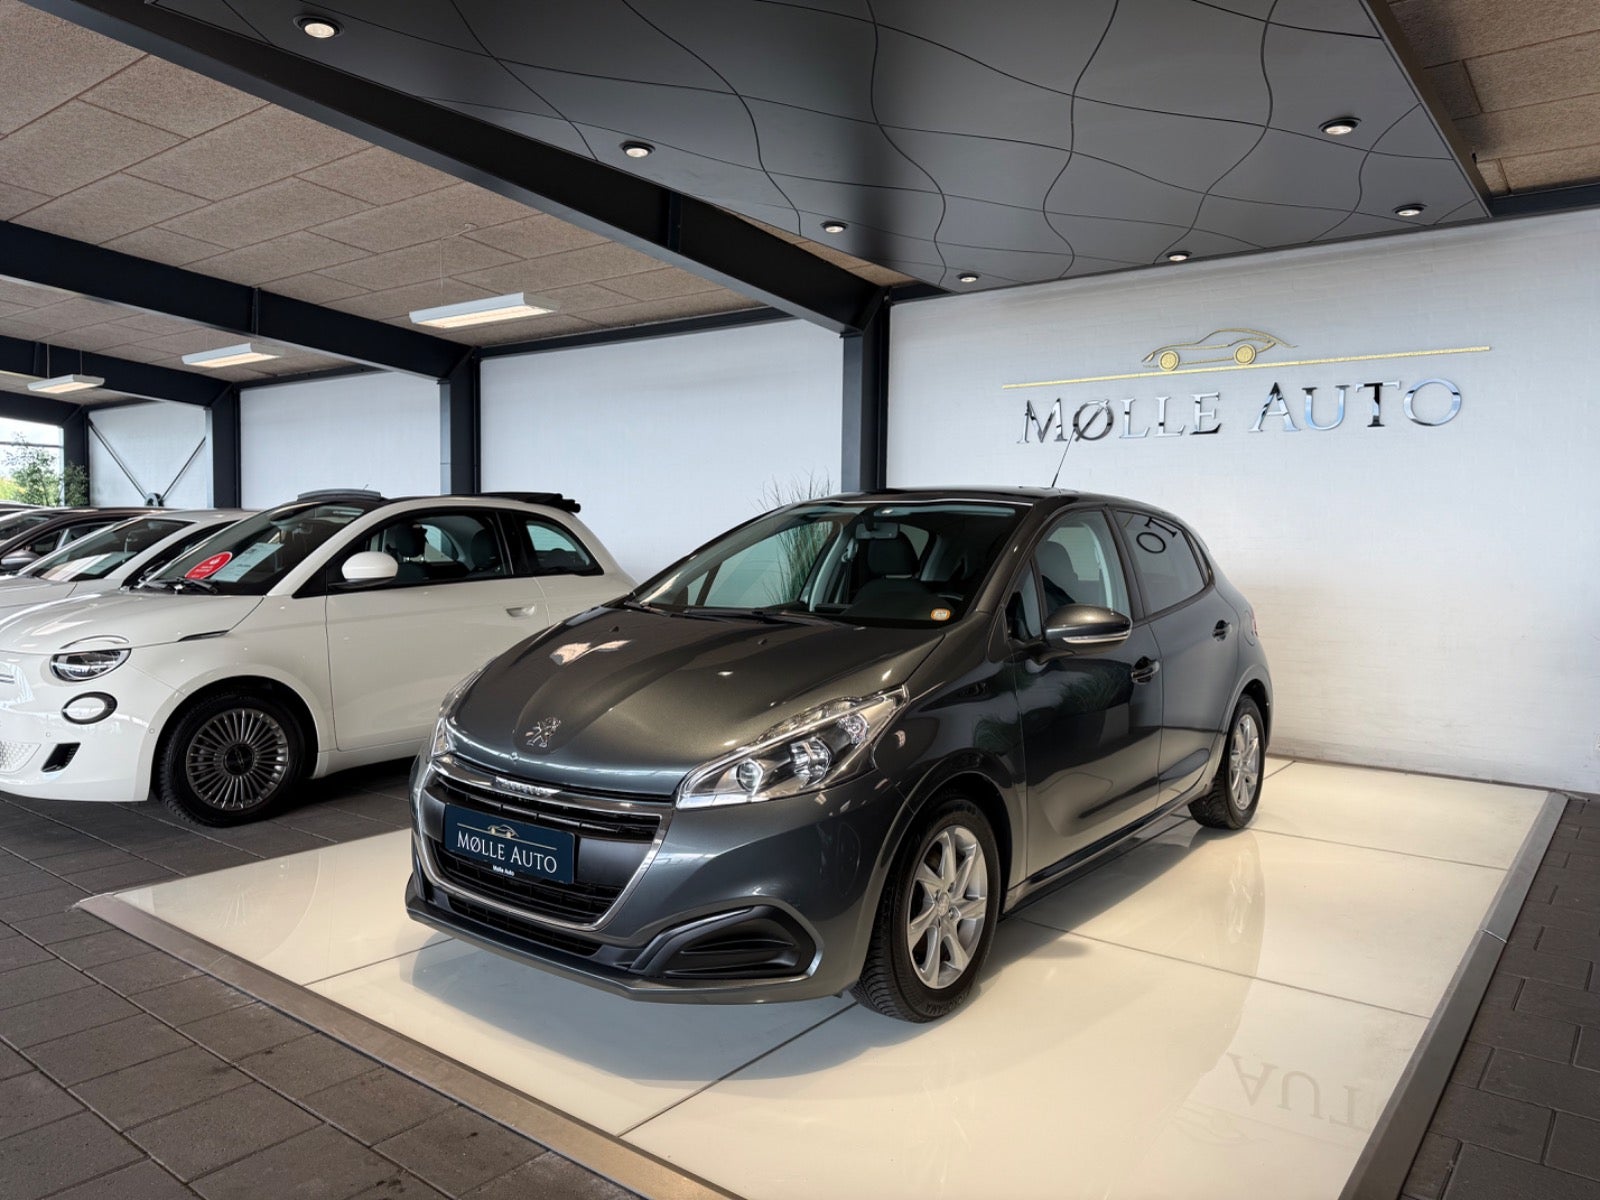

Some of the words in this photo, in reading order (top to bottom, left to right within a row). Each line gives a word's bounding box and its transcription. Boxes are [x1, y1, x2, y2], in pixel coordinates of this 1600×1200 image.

[1017, 391, 1222, 443] MØLLE
[1248, 378, 1462, 432] AUTO
[457, 830, 505, 861] MØLLE
[510, 846, 557, 874] AUTO
